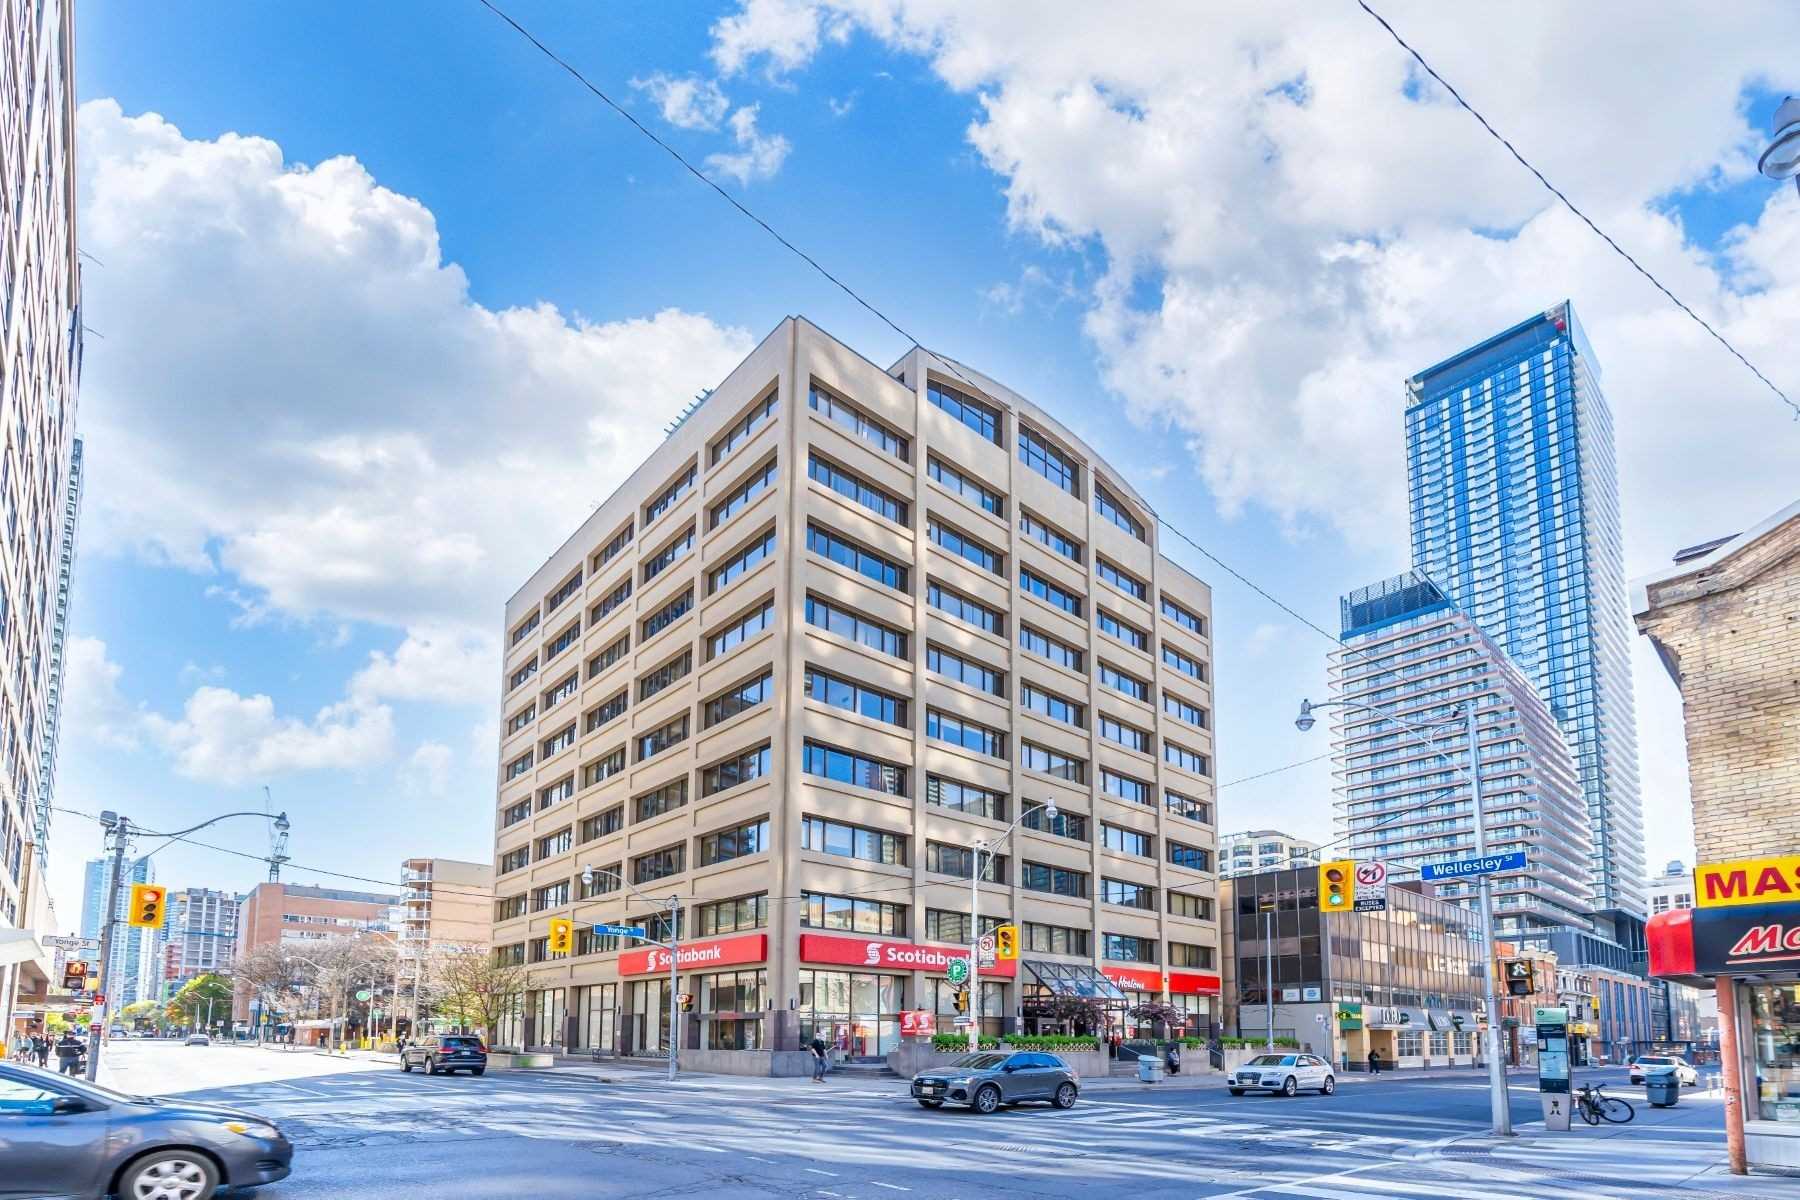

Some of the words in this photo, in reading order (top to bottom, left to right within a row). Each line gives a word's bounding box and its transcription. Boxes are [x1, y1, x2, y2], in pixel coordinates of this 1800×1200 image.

[1433, 858, 1502, 876] Wellesley
[1704, 866, 1800, 900] MA
[607, 926, 628, 934] Yonge
[659, 945, 721, 965] Sctiabank
[887, 947, 970, 965] Scotiaba
[952, 965, 961, 977] P
[1118, 975, 1145, 990] Hortons
